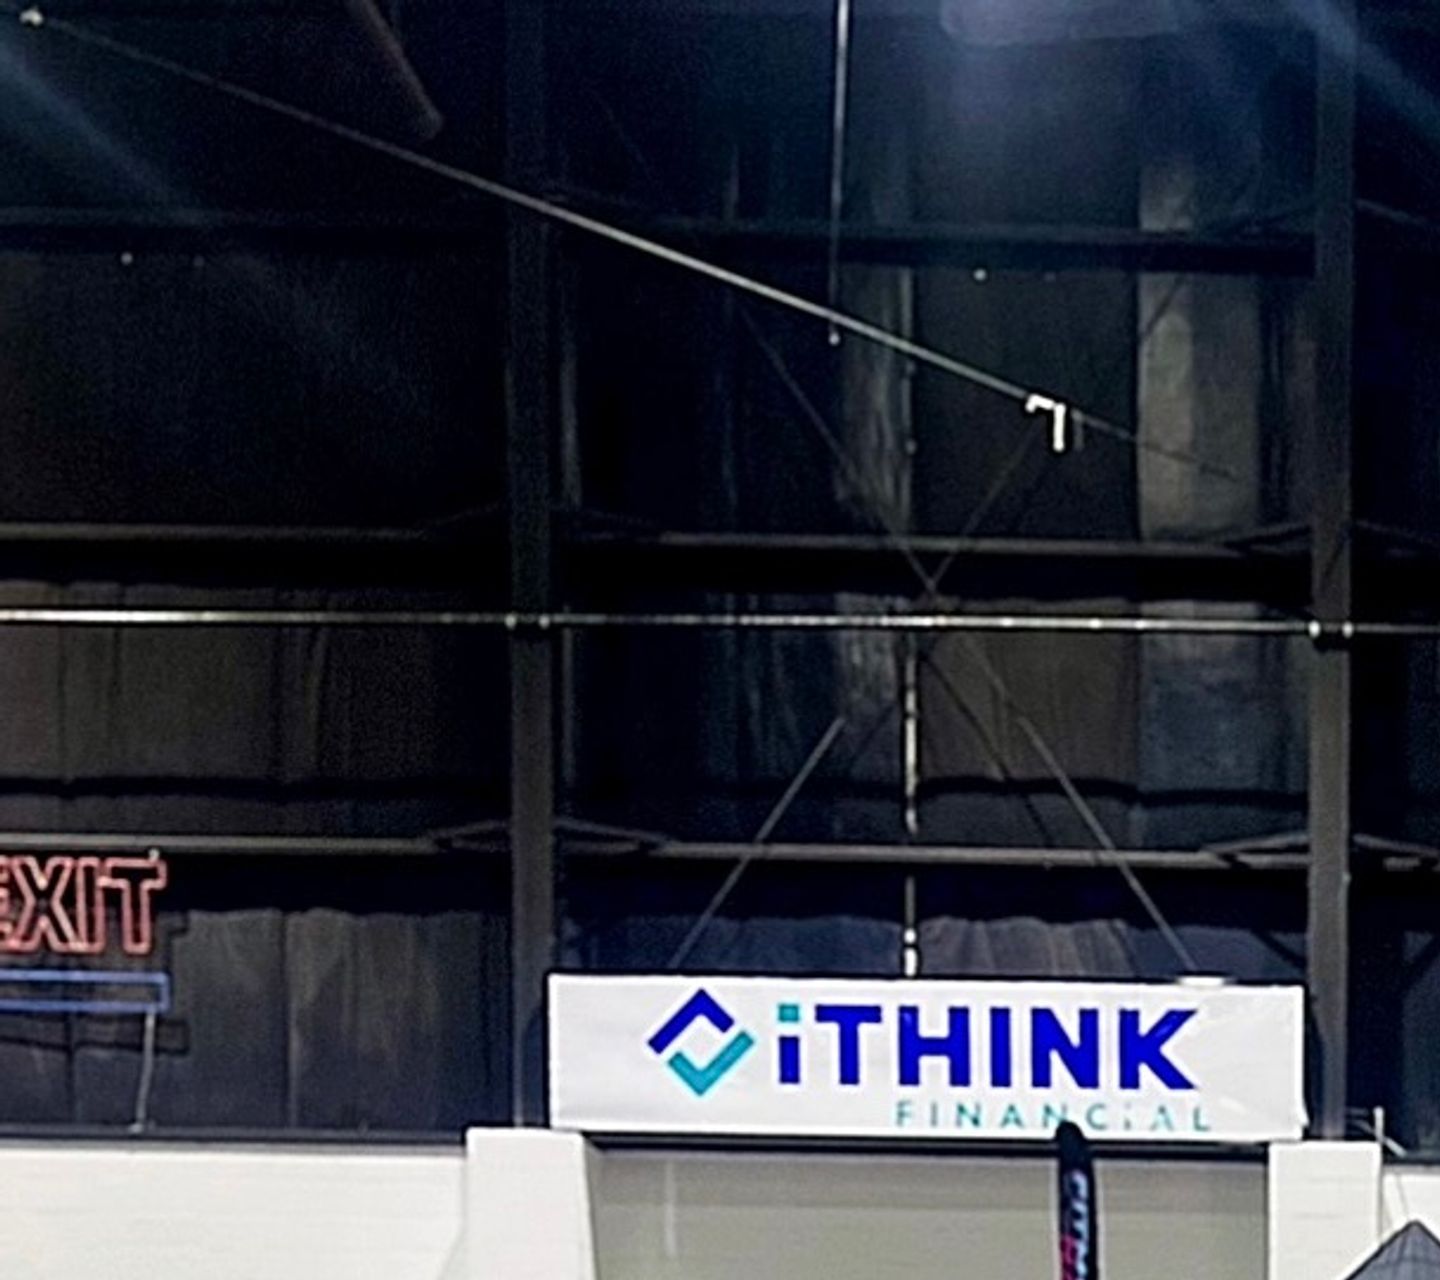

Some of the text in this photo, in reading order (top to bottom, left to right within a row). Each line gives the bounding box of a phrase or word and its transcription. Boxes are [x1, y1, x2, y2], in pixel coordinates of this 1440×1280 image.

[0, 856, 167, 955] XIT
[778, 1003, 1198, 1090] iTHINK
[896, 1100, 1211, 1132] FINANCIAL
